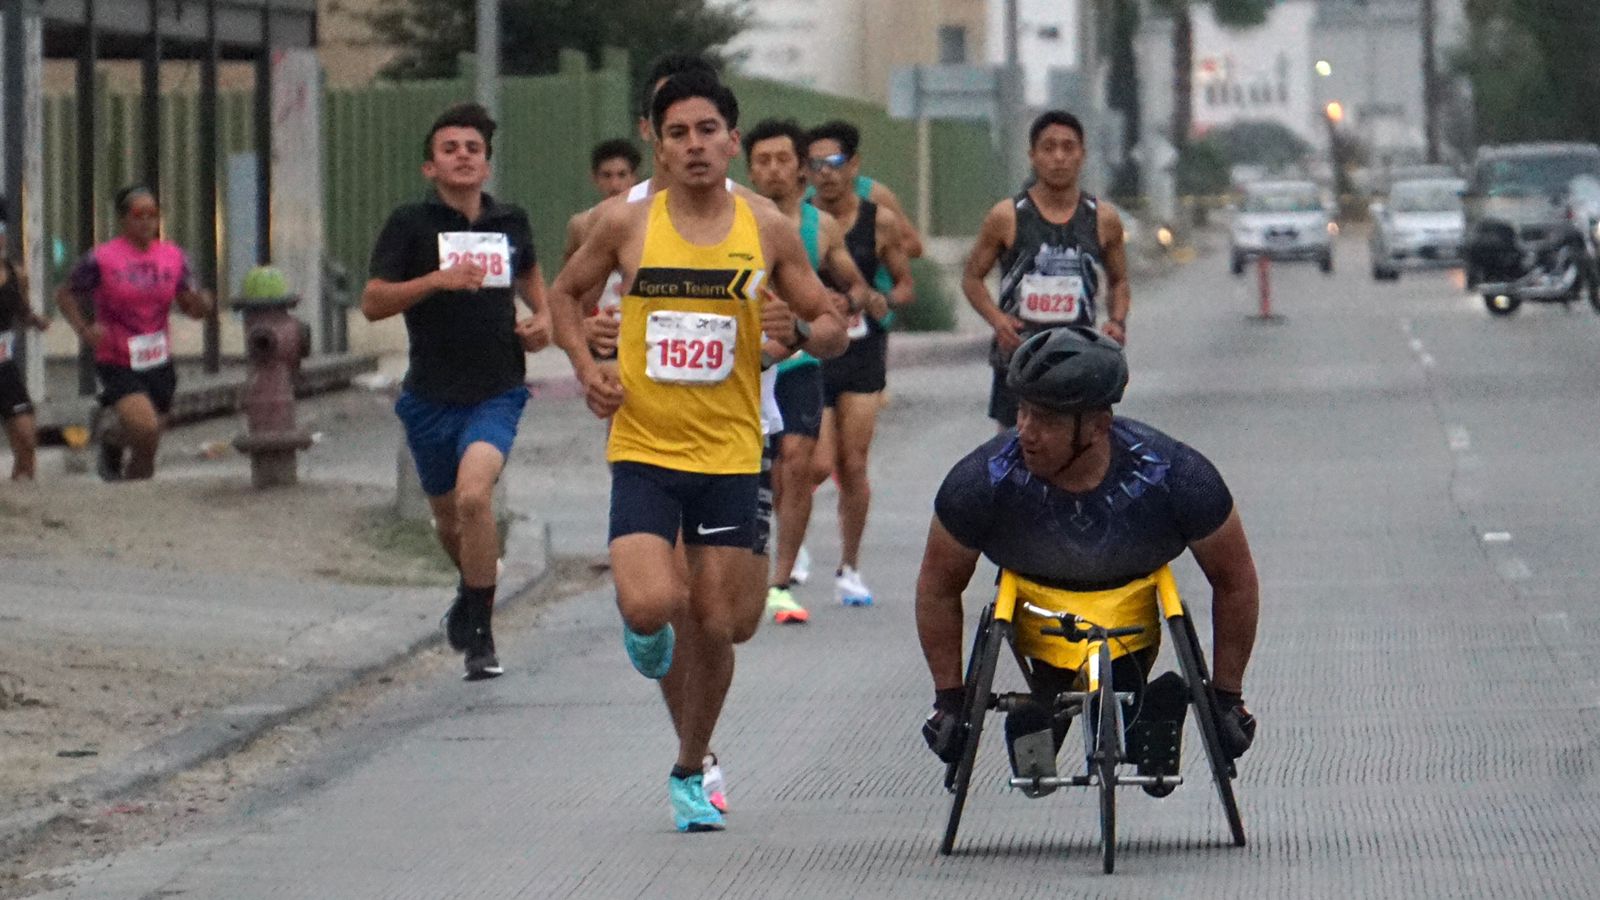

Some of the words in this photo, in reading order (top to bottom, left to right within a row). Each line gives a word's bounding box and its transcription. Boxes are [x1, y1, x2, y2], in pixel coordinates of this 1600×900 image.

[639, 280, 678, 295] Force
[683, 280, 725, 295] Team
[1026, 292, 1075, 313] 0623
[657, 338, 724, 370] 1529
